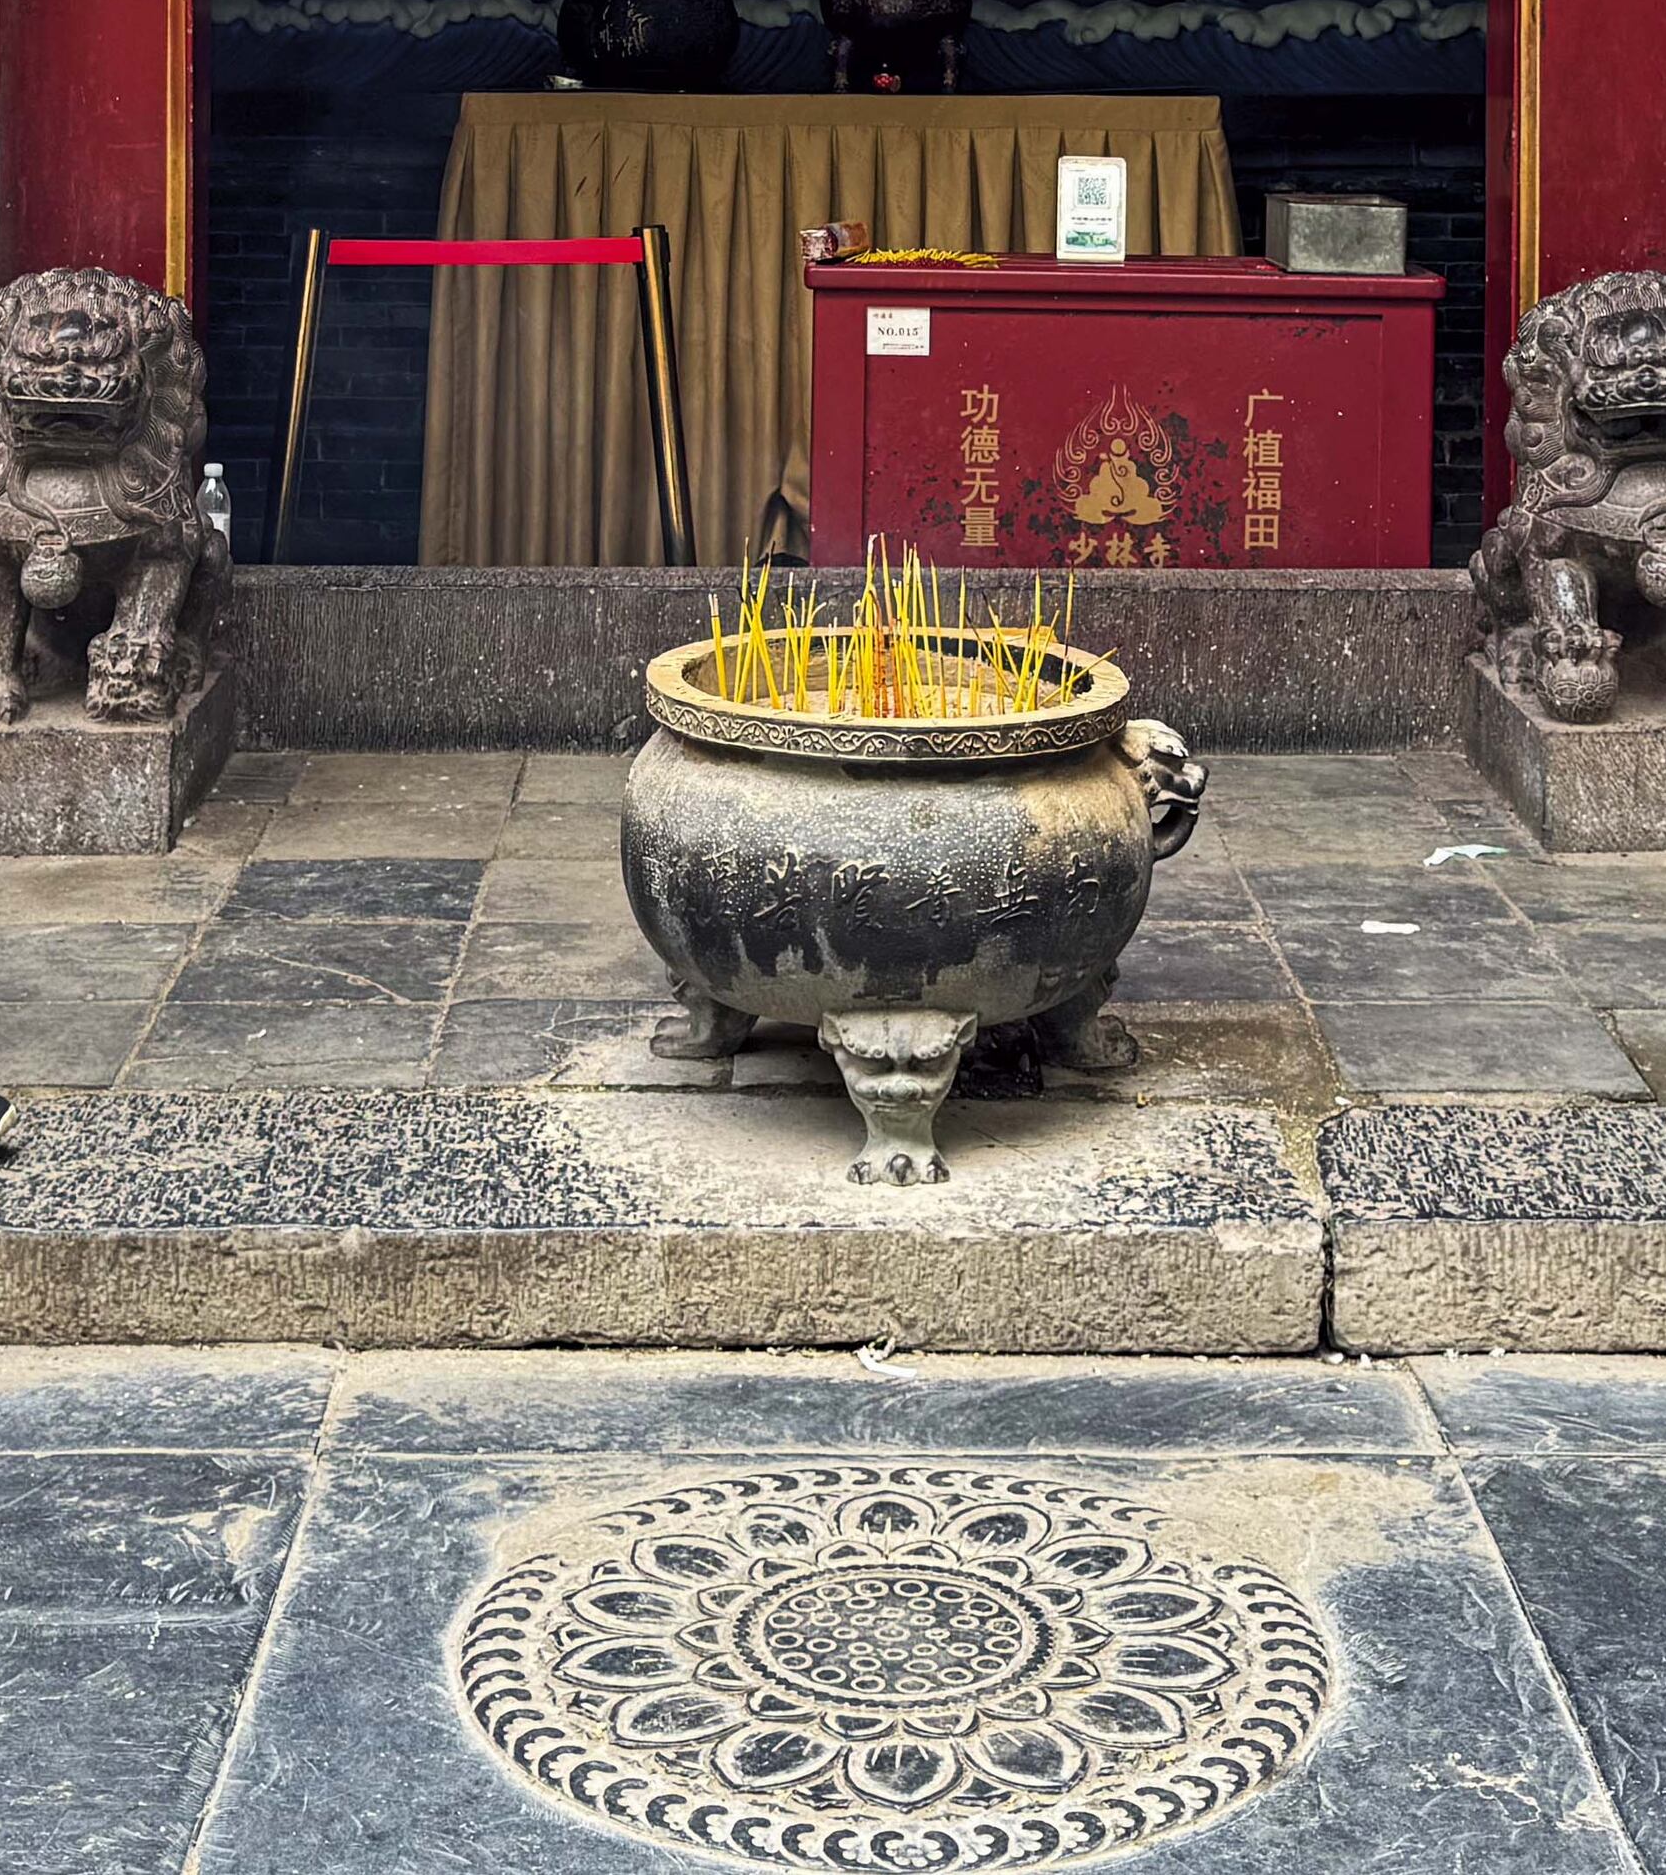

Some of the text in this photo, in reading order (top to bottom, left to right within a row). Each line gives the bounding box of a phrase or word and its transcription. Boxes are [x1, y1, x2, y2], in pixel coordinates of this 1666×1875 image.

[960, 384, 1000, 547] 功德无量
[1242, 388, 1284, 550] 广植福田
[1066, 532, 1171, 568] 少林寺
